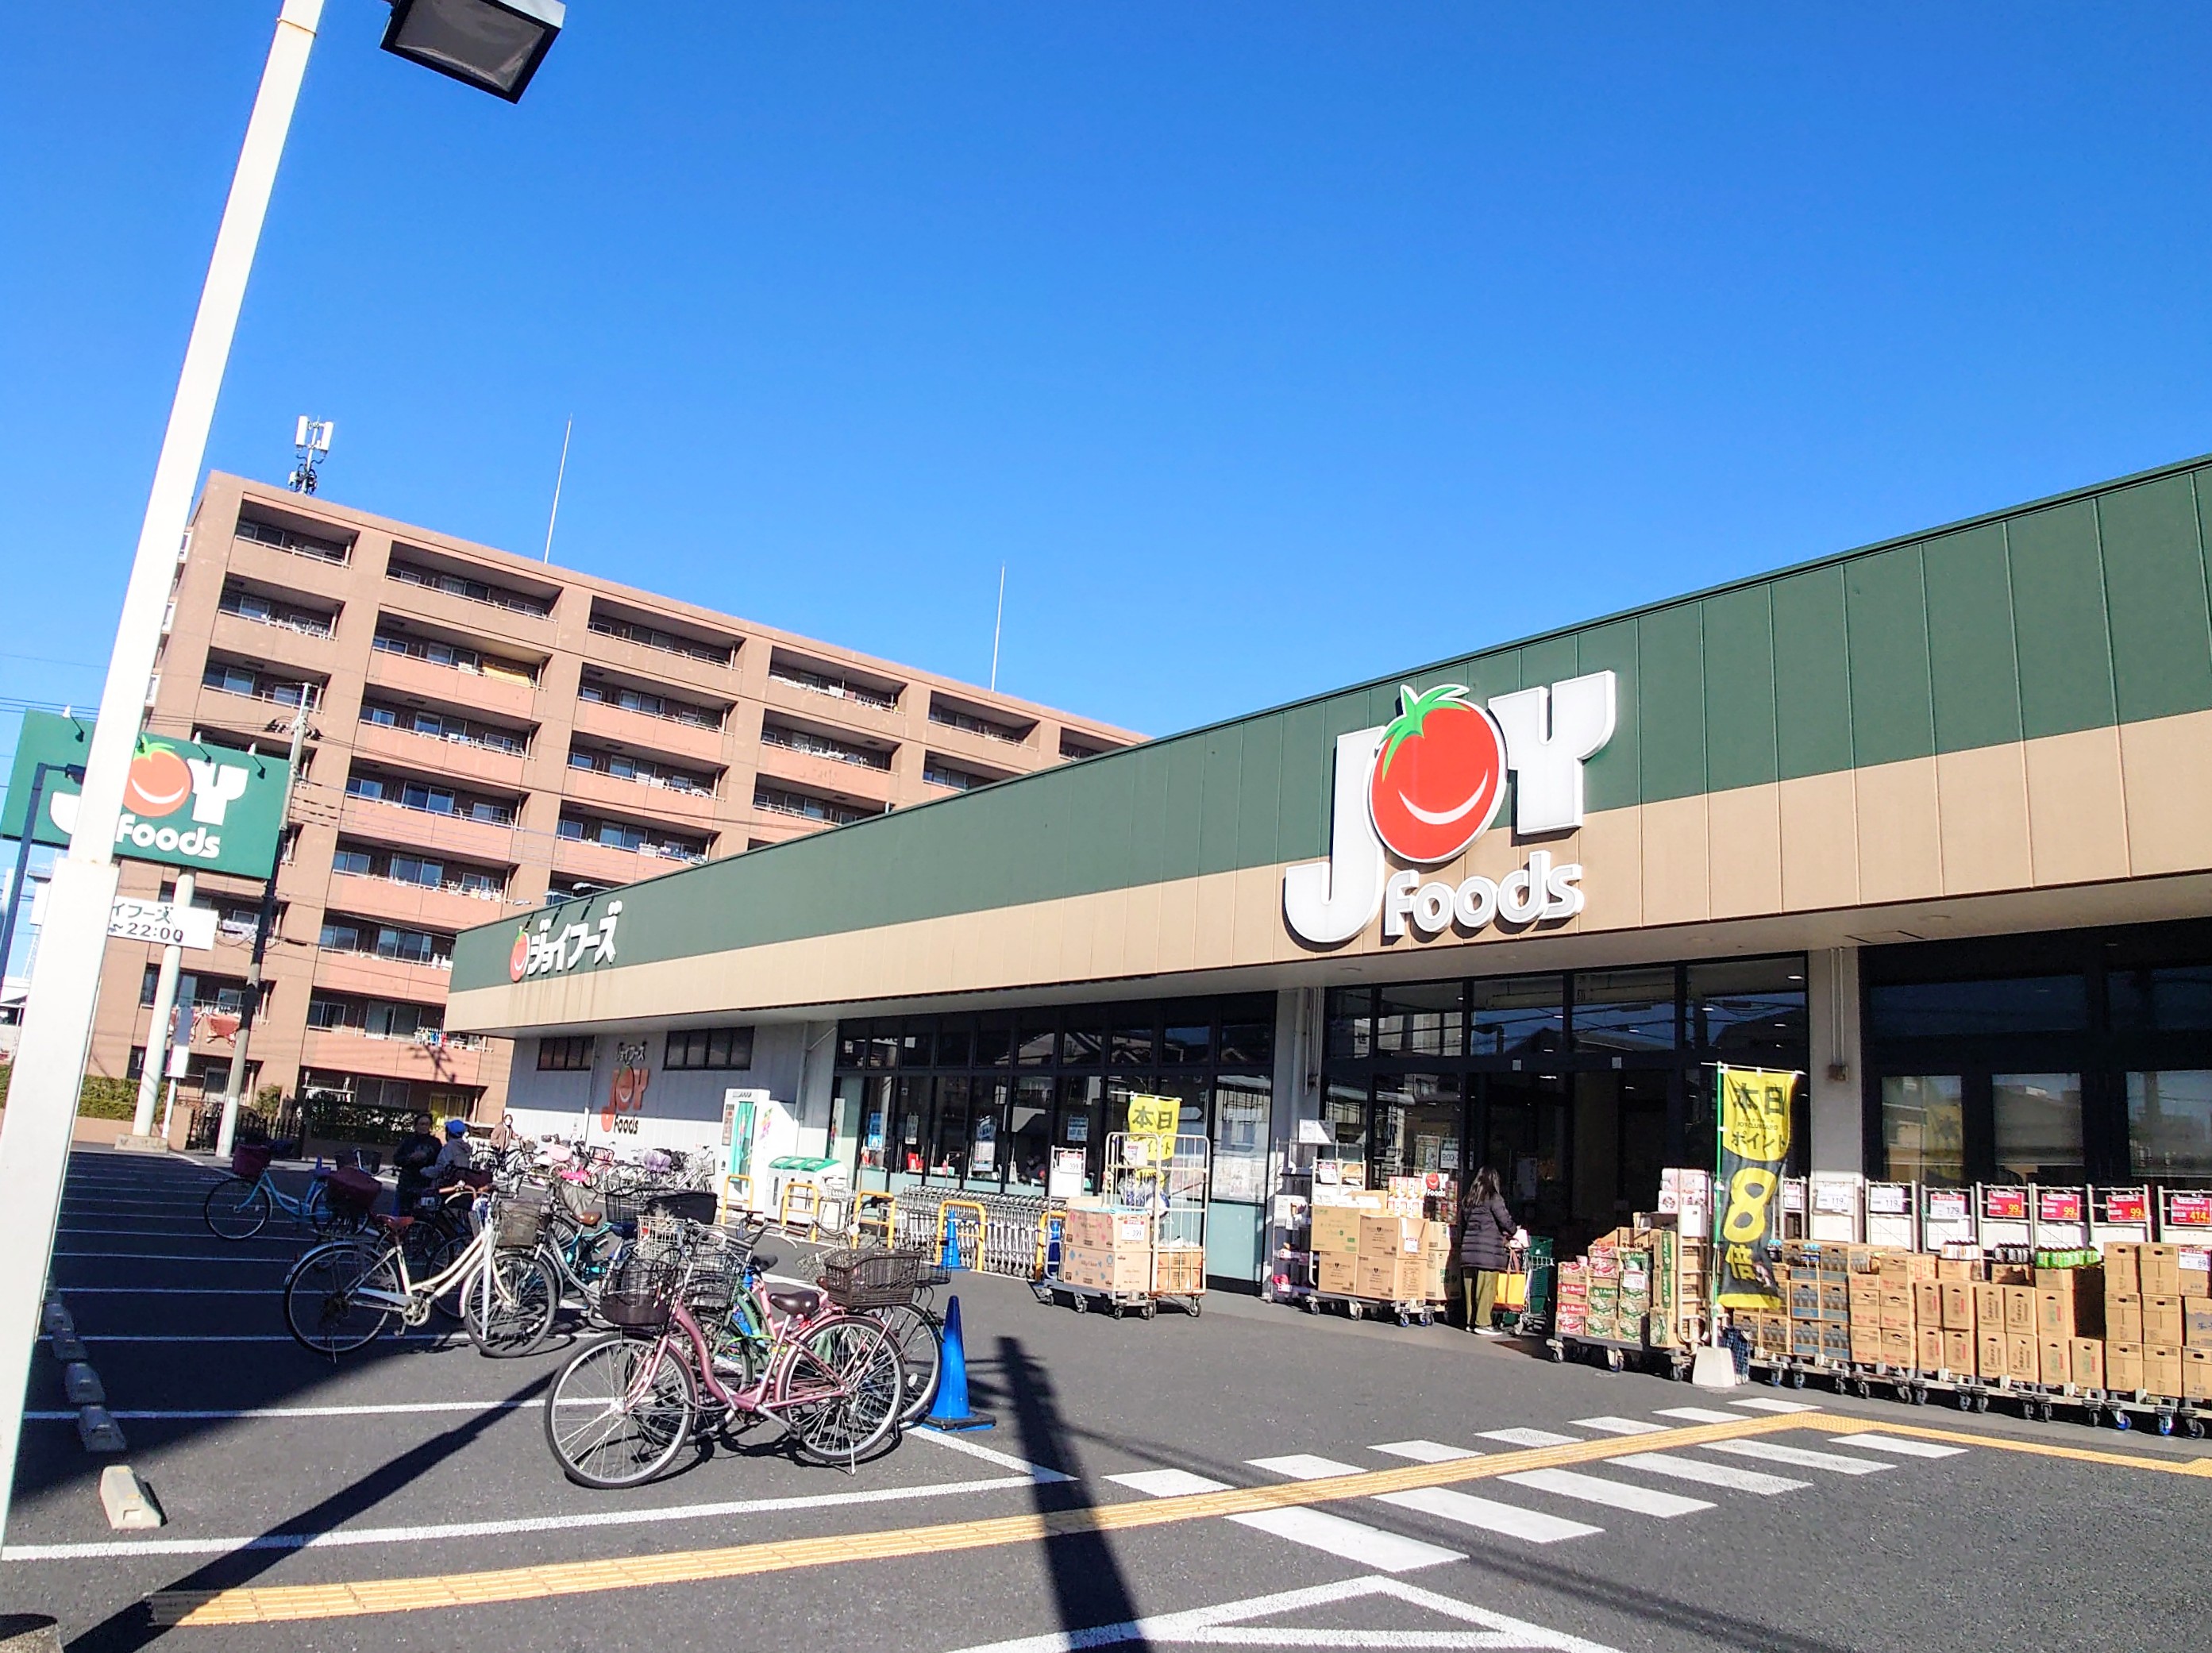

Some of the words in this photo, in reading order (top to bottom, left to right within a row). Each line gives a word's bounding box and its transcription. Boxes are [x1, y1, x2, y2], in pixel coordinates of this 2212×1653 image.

[1285, 669, 1616, 943] JOY
[112, 903, 174, 924] イフーズ
[526, 900, 623, 976] ジョイフーズ
[1732, 1082, 1785, 1116] 本日
[1132, 1105, 1173, 1131] 本日
[1731, 1131, 1786, 1154] ポイント
[1723, 1167, 1778, 1243] 8
[1886, 1199, 1898, 1208] 119
[2008, 1204, 2019, 1213] 99
[2064, 1207, 2075, 1216] 99
[2130, 1208, 2141, 1217] 99
[2190, 1211, 2206, 1220] 414
[1725, 1243, 1756, 1281] 倍
